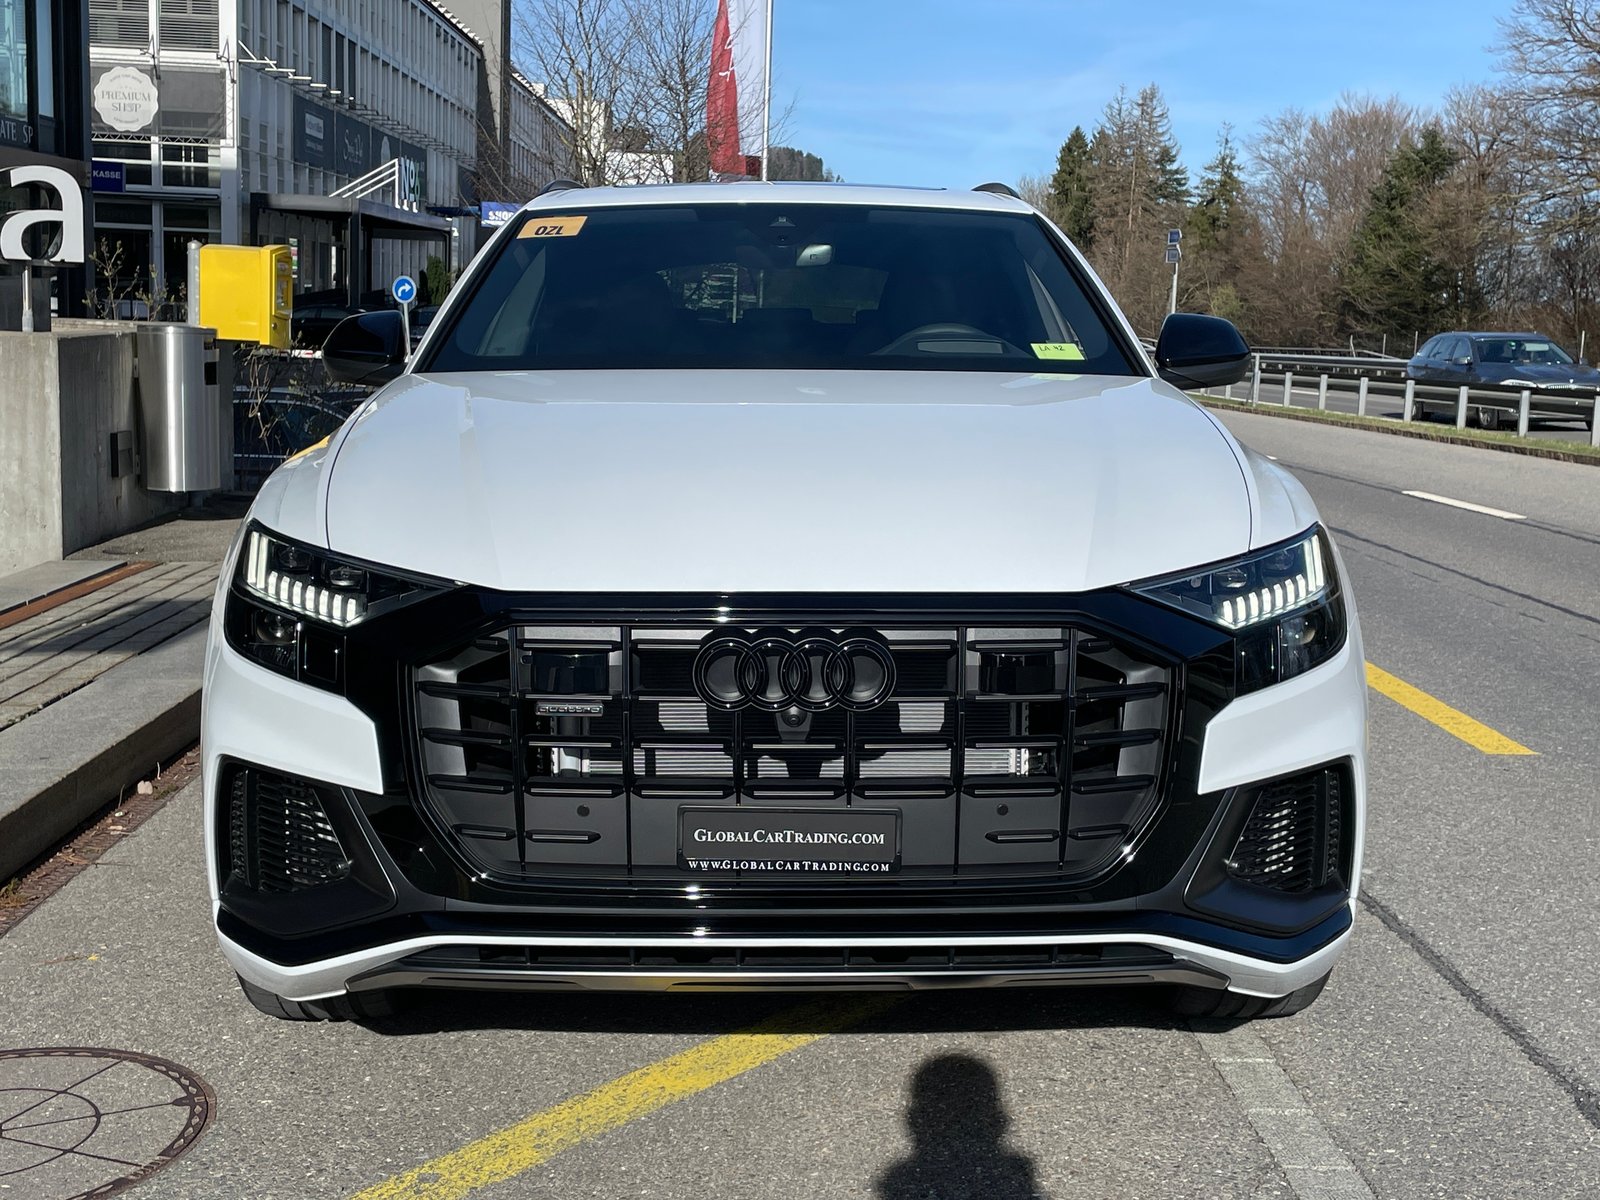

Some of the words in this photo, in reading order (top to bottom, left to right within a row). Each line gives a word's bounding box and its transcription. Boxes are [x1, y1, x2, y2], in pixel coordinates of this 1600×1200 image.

[102, 90, 151, 102] PREMIUM
[93, 170, 121, 179] KASSE
[693, 829, 885, 845] GLOBALCARTRADING.COM
